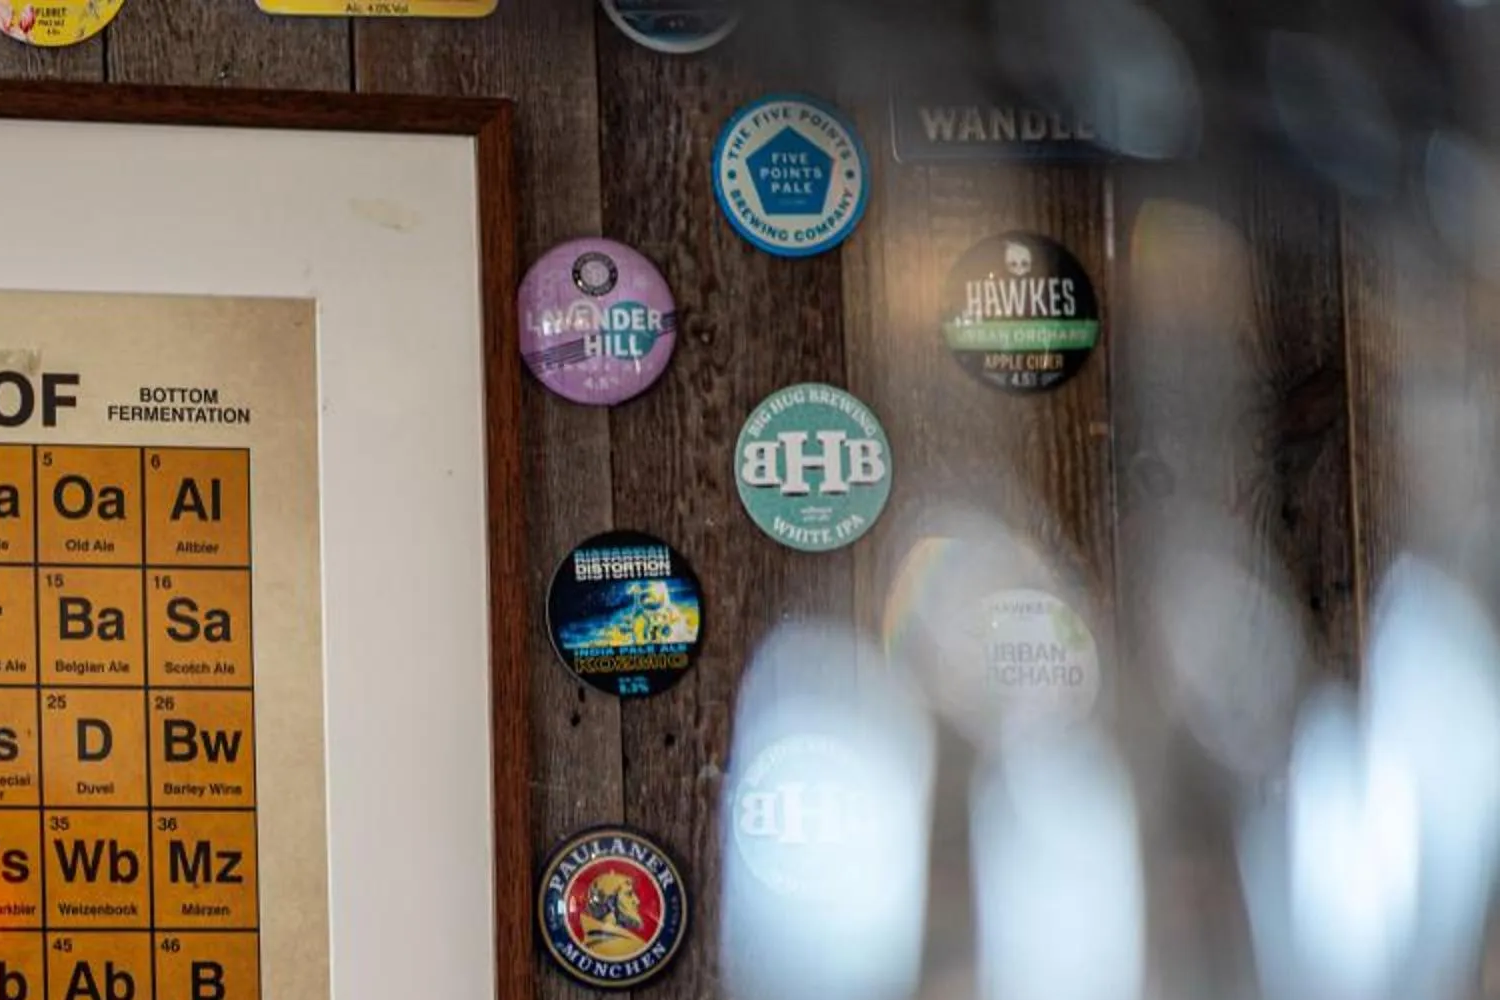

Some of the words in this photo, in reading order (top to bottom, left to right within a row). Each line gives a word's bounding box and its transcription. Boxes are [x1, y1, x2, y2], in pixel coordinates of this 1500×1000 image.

[771, 152, 808, 164] FIVE
[759, 167, 822, 180] POINTS
[771, 182, 812, 194] PALE
[966, 277, 1076, 317] HAWKES
[583, 334, 643, 356] HILL
[139, 387, 219, 405] BOTTOM
[107, 405, 252, 425] FERMENTATION
[748, 410, 773, 438] BIG
[770, 390, 805, 415] HUG
[809, 388, 877, 437] BREWING
[773, 515, 833, 544] WHITE
[835, 513, 865, 539] IPA
[58, 596, 125, 642] Ba
[5, 660, 26, 672] Ale
[164, 718, 242, 764] Bw
[549, 837, 674, 893] PAULANER
[52, 938, 72, 953] 45
